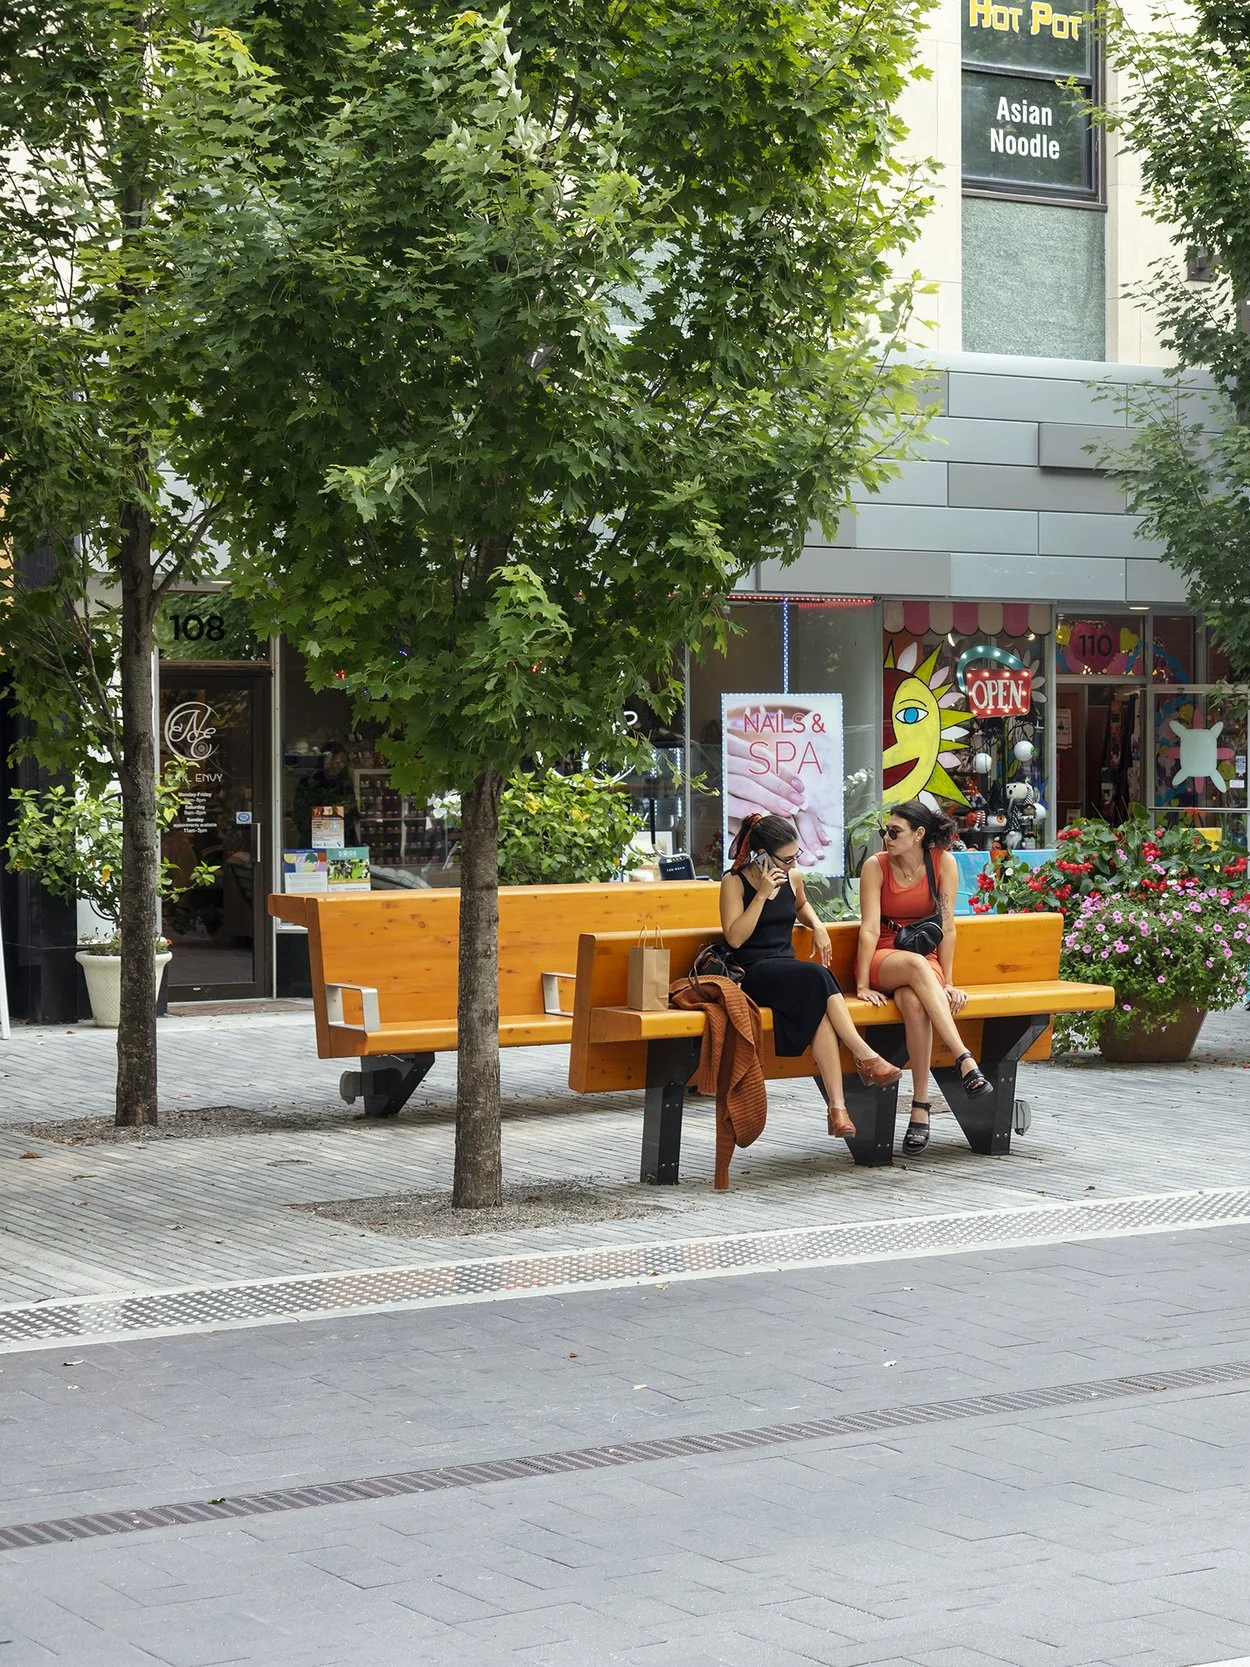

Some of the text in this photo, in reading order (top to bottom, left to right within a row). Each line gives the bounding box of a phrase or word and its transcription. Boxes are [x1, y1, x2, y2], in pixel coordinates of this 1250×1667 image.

[996, 96, 1053, 126] Asian
[990, 128, 1060, 160] Noodle
[169, 614, 225, 641] 108
[1079, 634, 1113, 657] 110
[971, 679, 1024, 710] OPEN
[744, 713, 826, 734] NAILS &
[748, 741, 822, 775] SPA
[195, 773, 223, 783] ENVY
